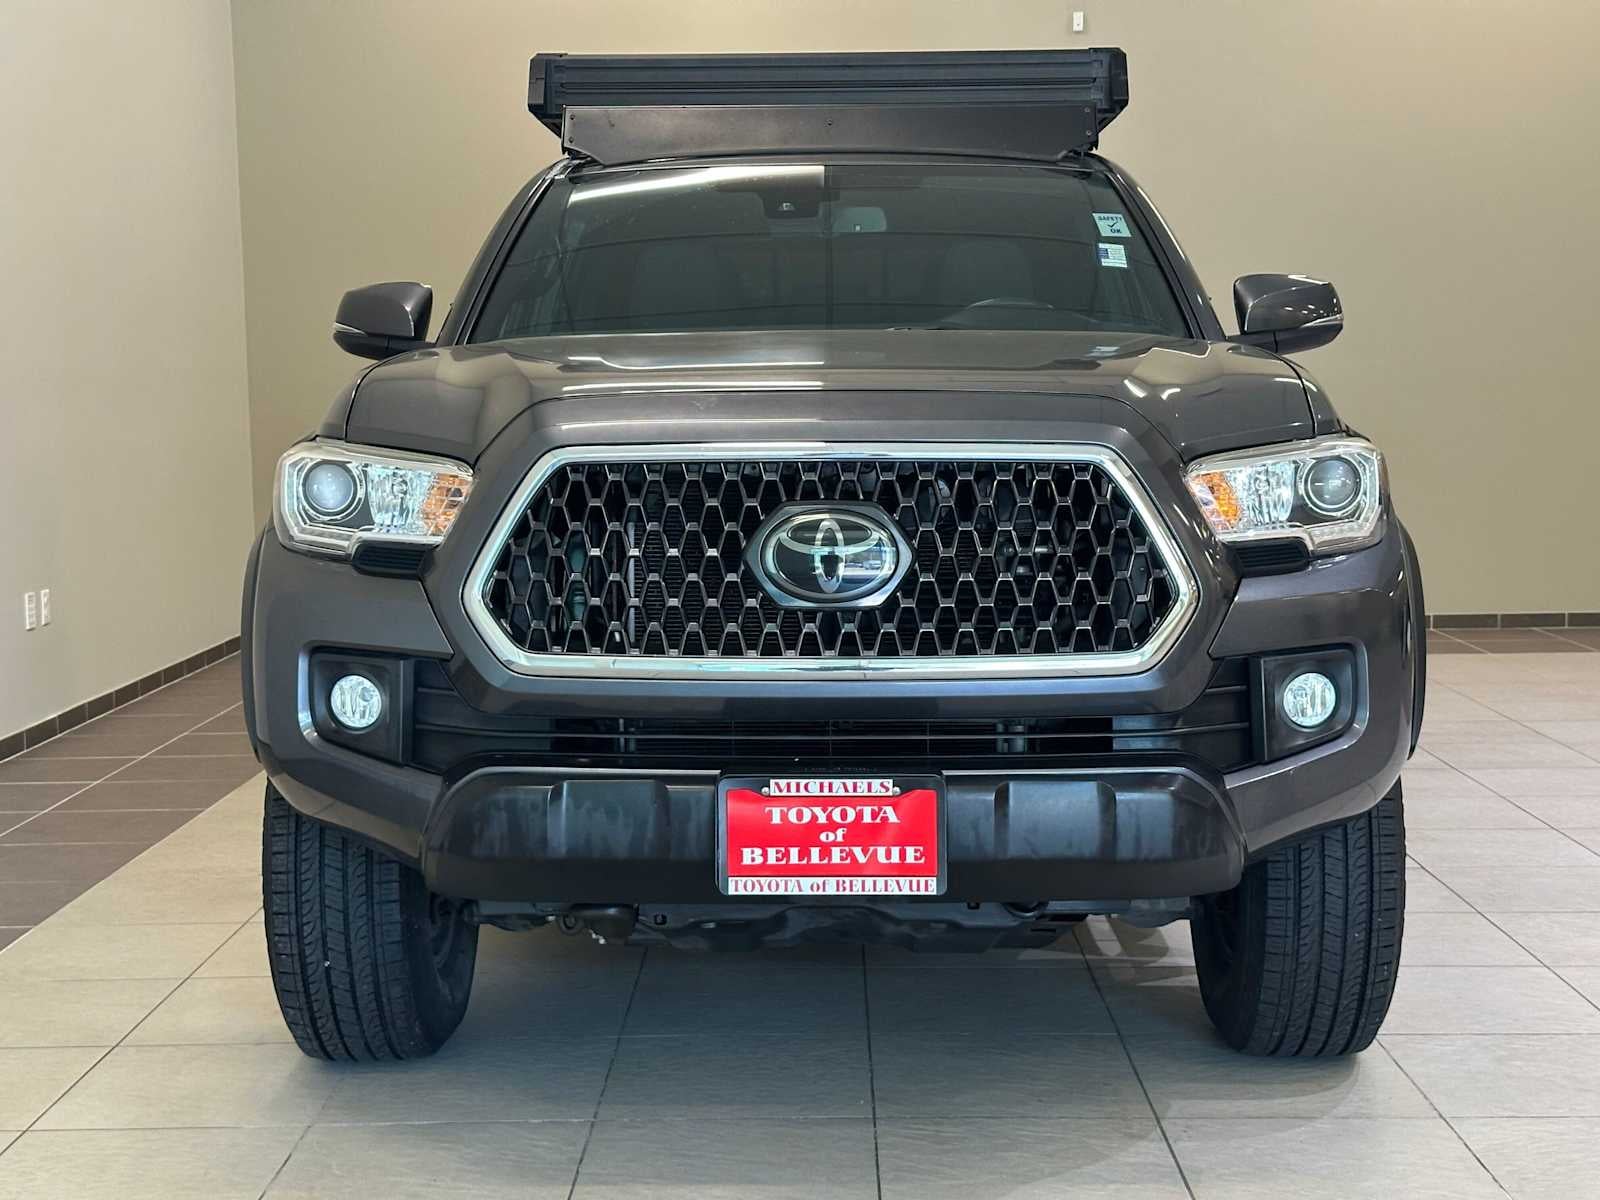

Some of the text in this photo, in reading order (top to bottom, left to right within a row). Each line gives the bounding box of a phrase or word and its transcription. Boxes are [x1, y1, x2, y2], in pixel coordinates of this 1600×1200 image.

[773, 780, 891, 794] MICHAELS
[764, 805, 901, 825] TOYOTA
[819, 828, 847, 843] of
[740, 846, 925, 866] BELLEVUE
[730, 878, 935, 893] TOYOTA of BELLEVUE
